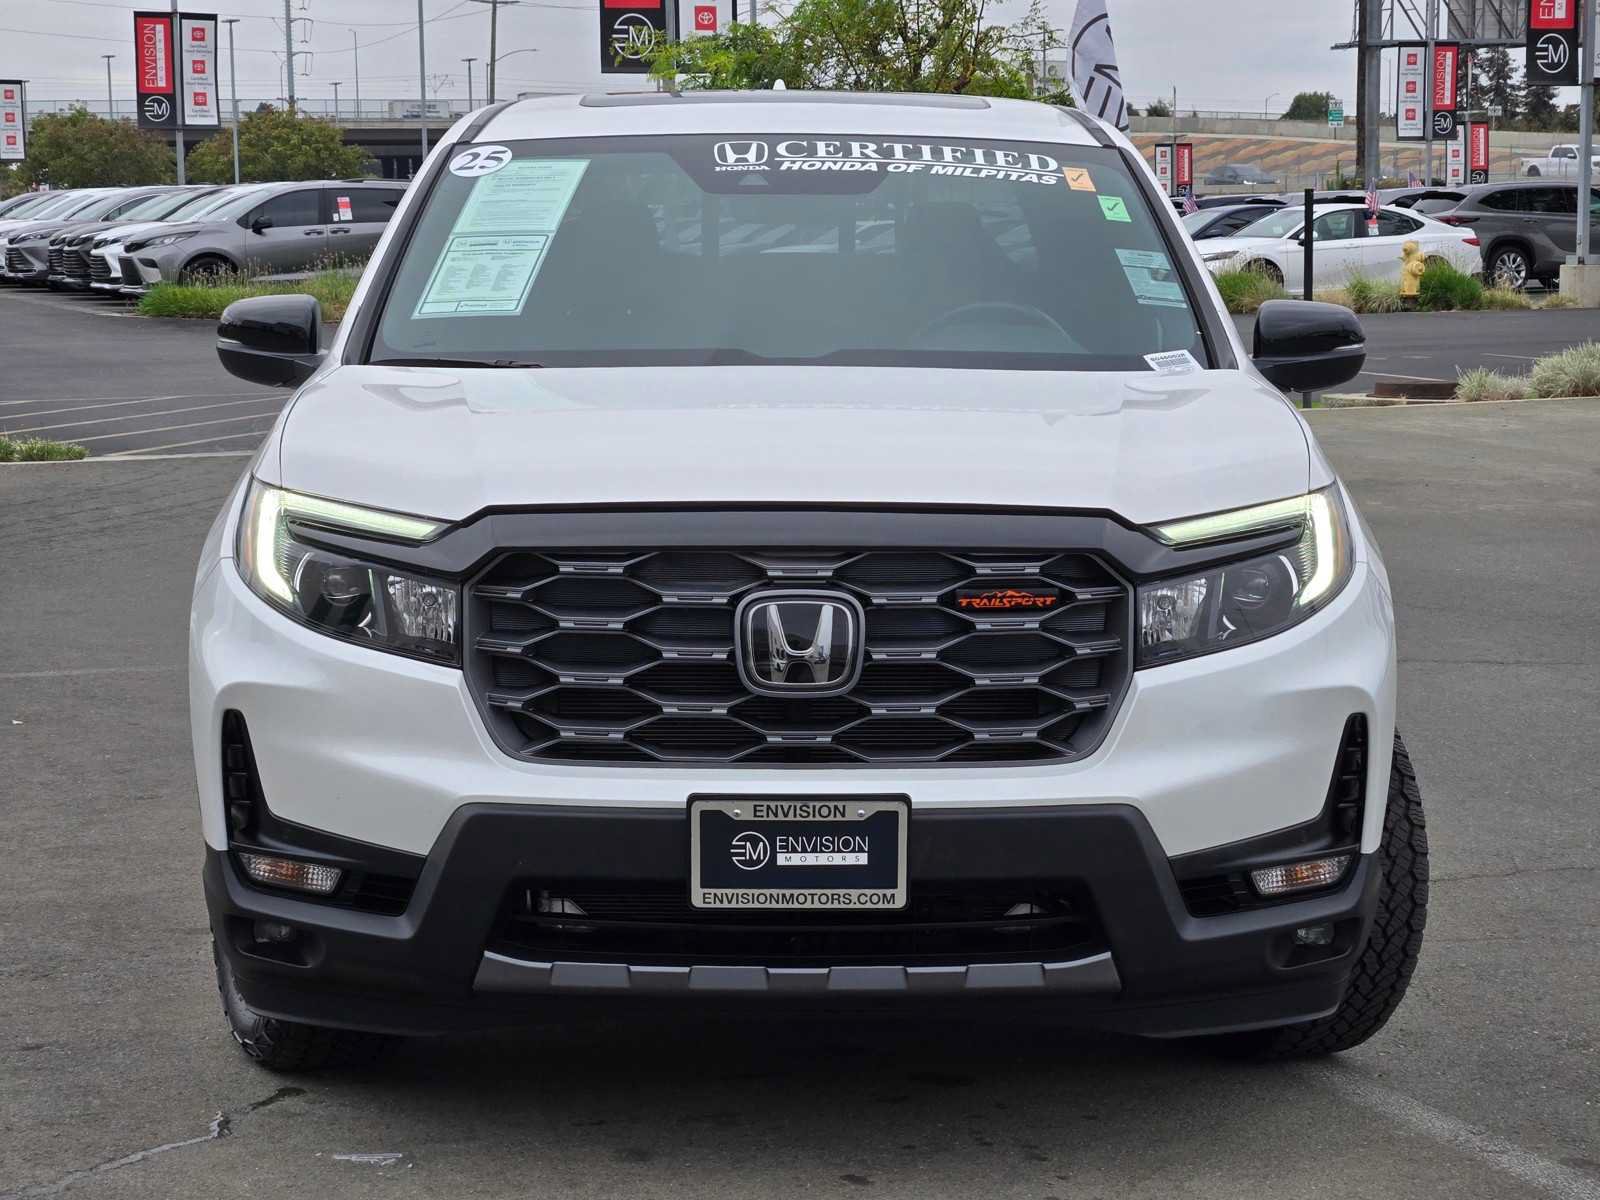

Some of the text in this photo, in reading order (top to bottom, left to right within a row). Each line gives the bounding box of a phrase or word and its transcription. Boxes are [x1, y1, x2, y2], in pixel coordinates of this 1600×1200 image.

[143, 24, 156, 87] ENVISION
[1436, 51, 1446, 104] ENVISION
[454, 150, 508, 171] 25
[775, 141, 1058, 171] CERTIFIED
[780, 160, 1059, 184] HONDA OF MILPITAS
[958, 597, 1056, 608] TRAILSPORT
[753, 804, 846, 818] ENVISION
[776, 836, 868, 852] ENVISION
[784, 855, 860, 863] MOTORS
[702, 893, 896, 905] ENVISIONMOTORS.COM
